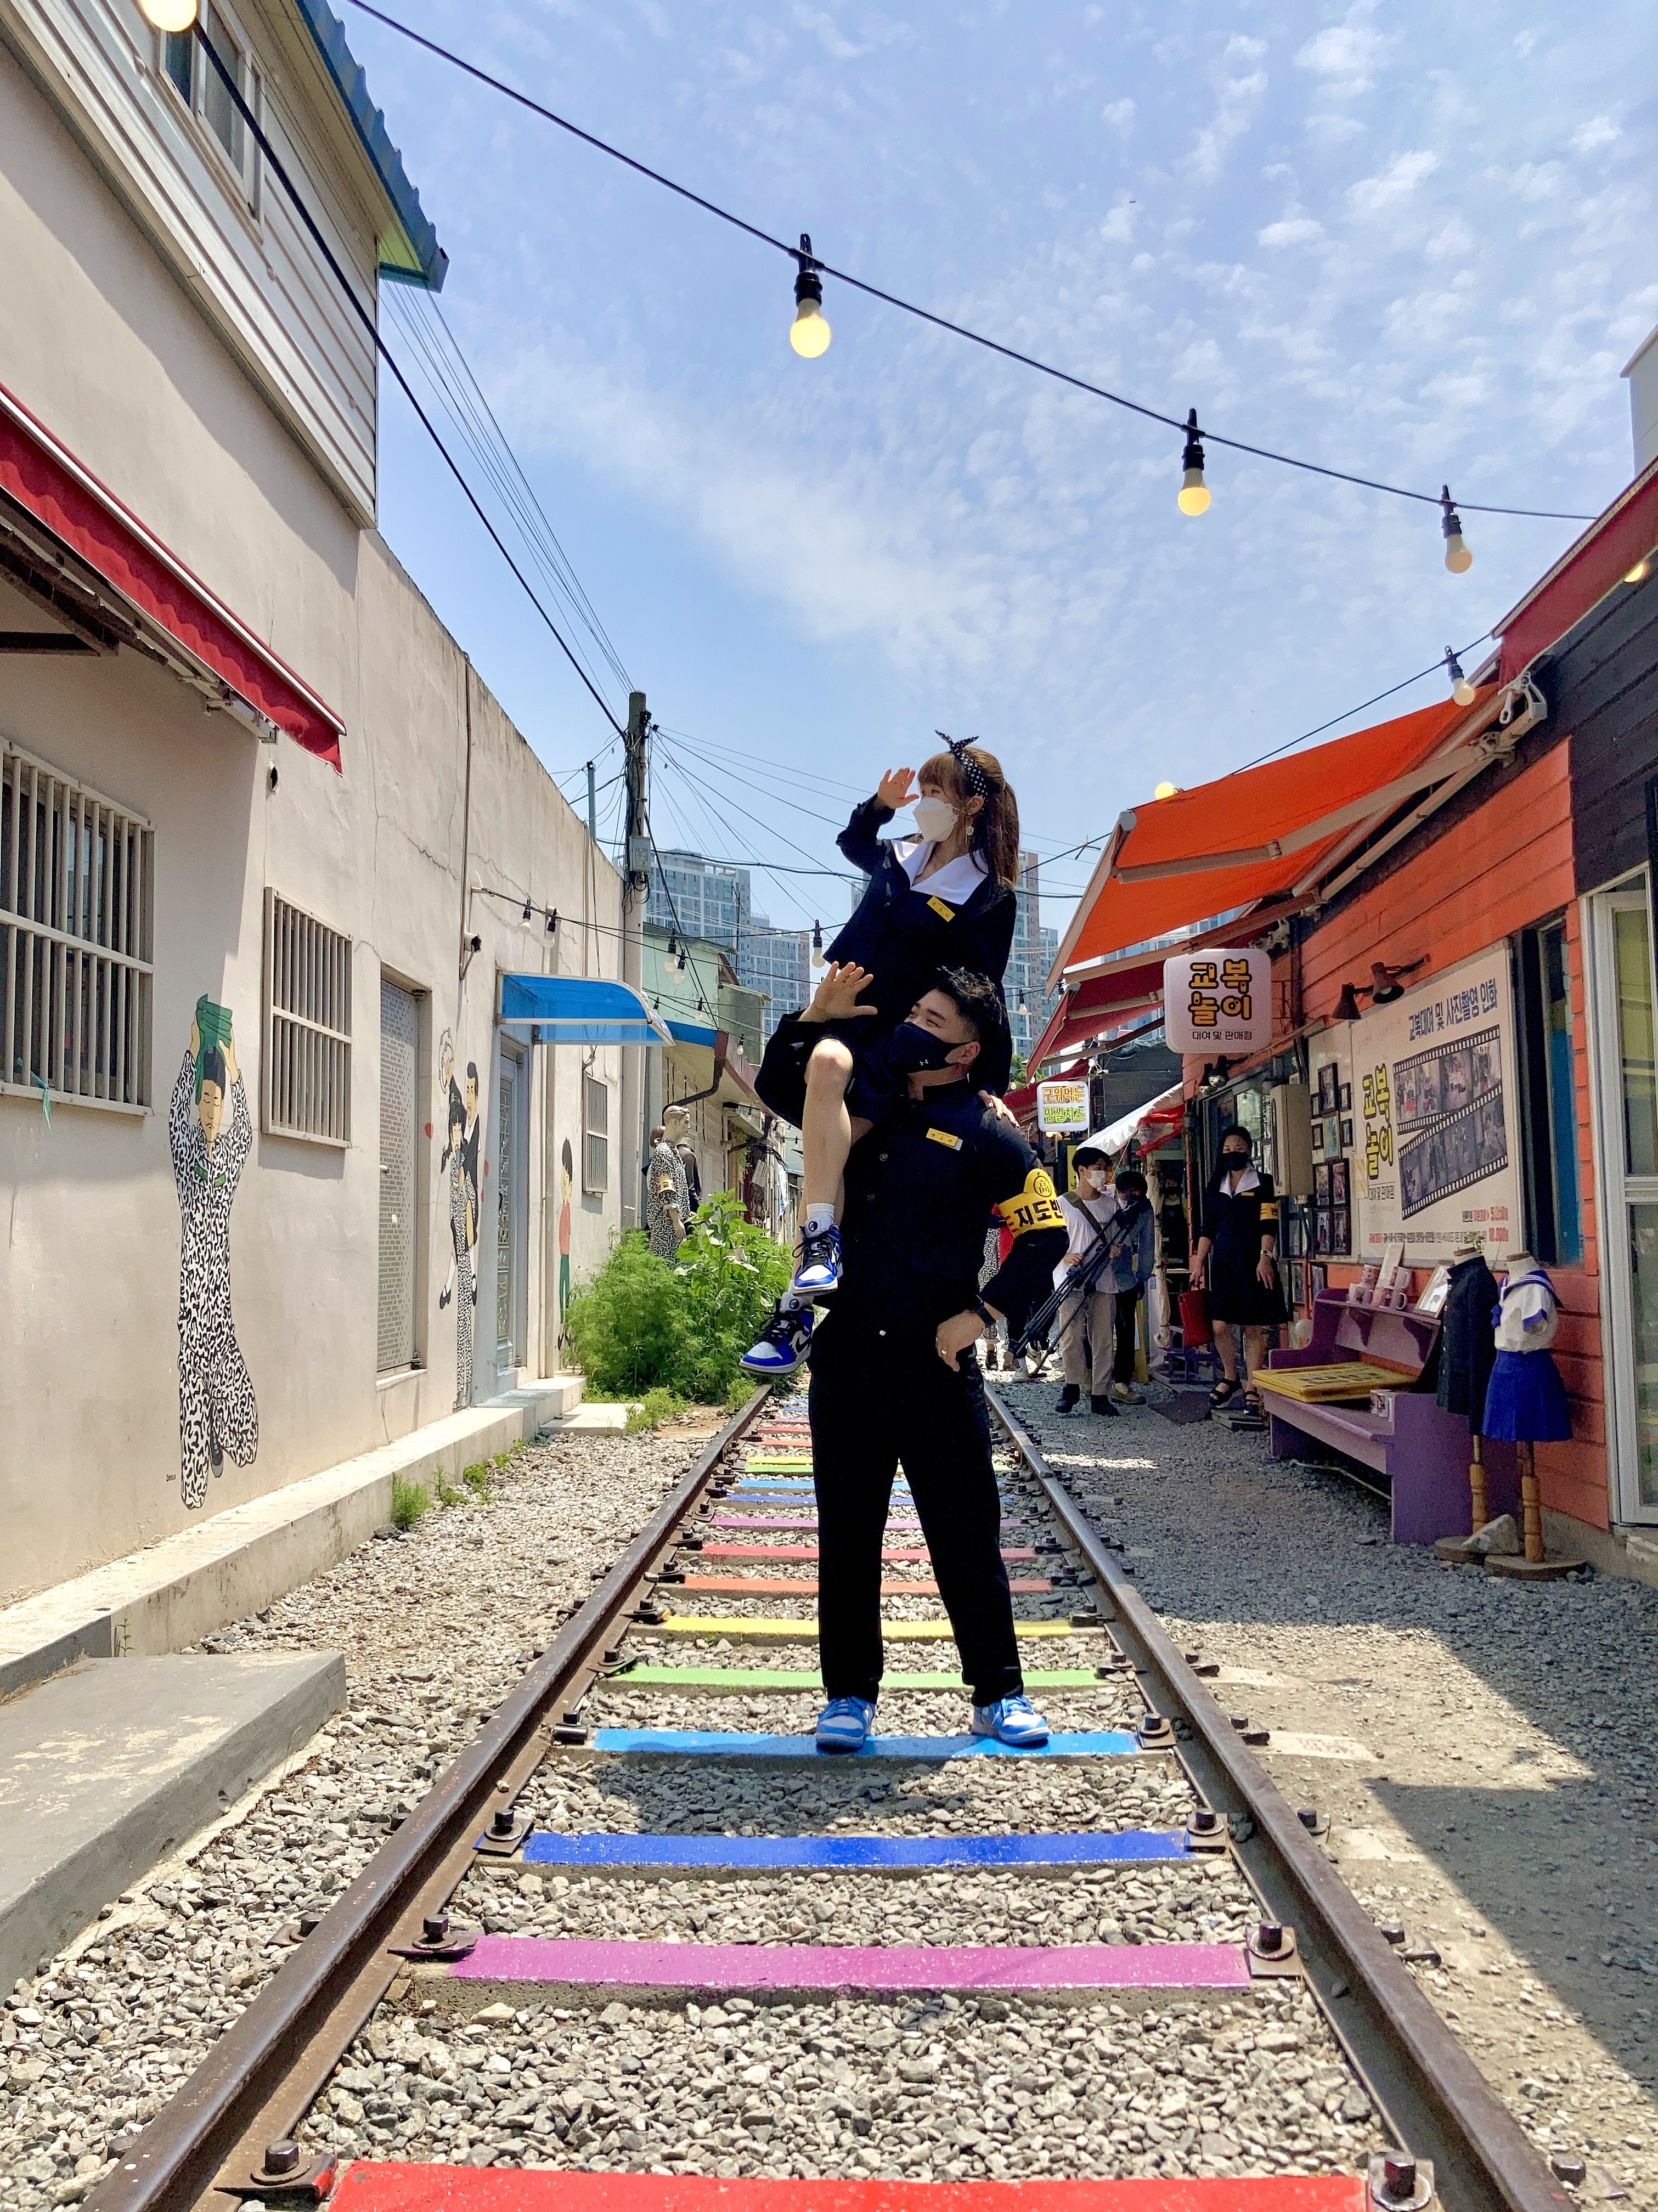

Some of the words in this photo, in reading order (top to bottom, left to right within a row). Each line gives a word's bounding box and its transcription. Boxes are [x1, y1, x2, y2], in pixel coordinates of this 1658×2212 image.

[1188, 958, 1253, 994] 교복
[1188, 990, 1253, 1026] 놀이
[1408, 1005, 1434, 1041] 교복대여
[1435, 1001, 1444, 1031] 및
[1446, 986, 1479, 1026] 사진촬영
[1480, 978, 1497, 1014] 인화
[1192, 1031, 1210, 1040] 대여
[1213, 1031, 1222, 1040] 및
[1225, 1031, 1252, 1040] 판매점
[1044, 1086, 1085, 1104] 구워먹는
[1363, 1063, 1390, 1123] 교복
[1044, 1107, 1085, 1124] 임실치즈
[1366, 1122, 1394, 1180] 놀이
